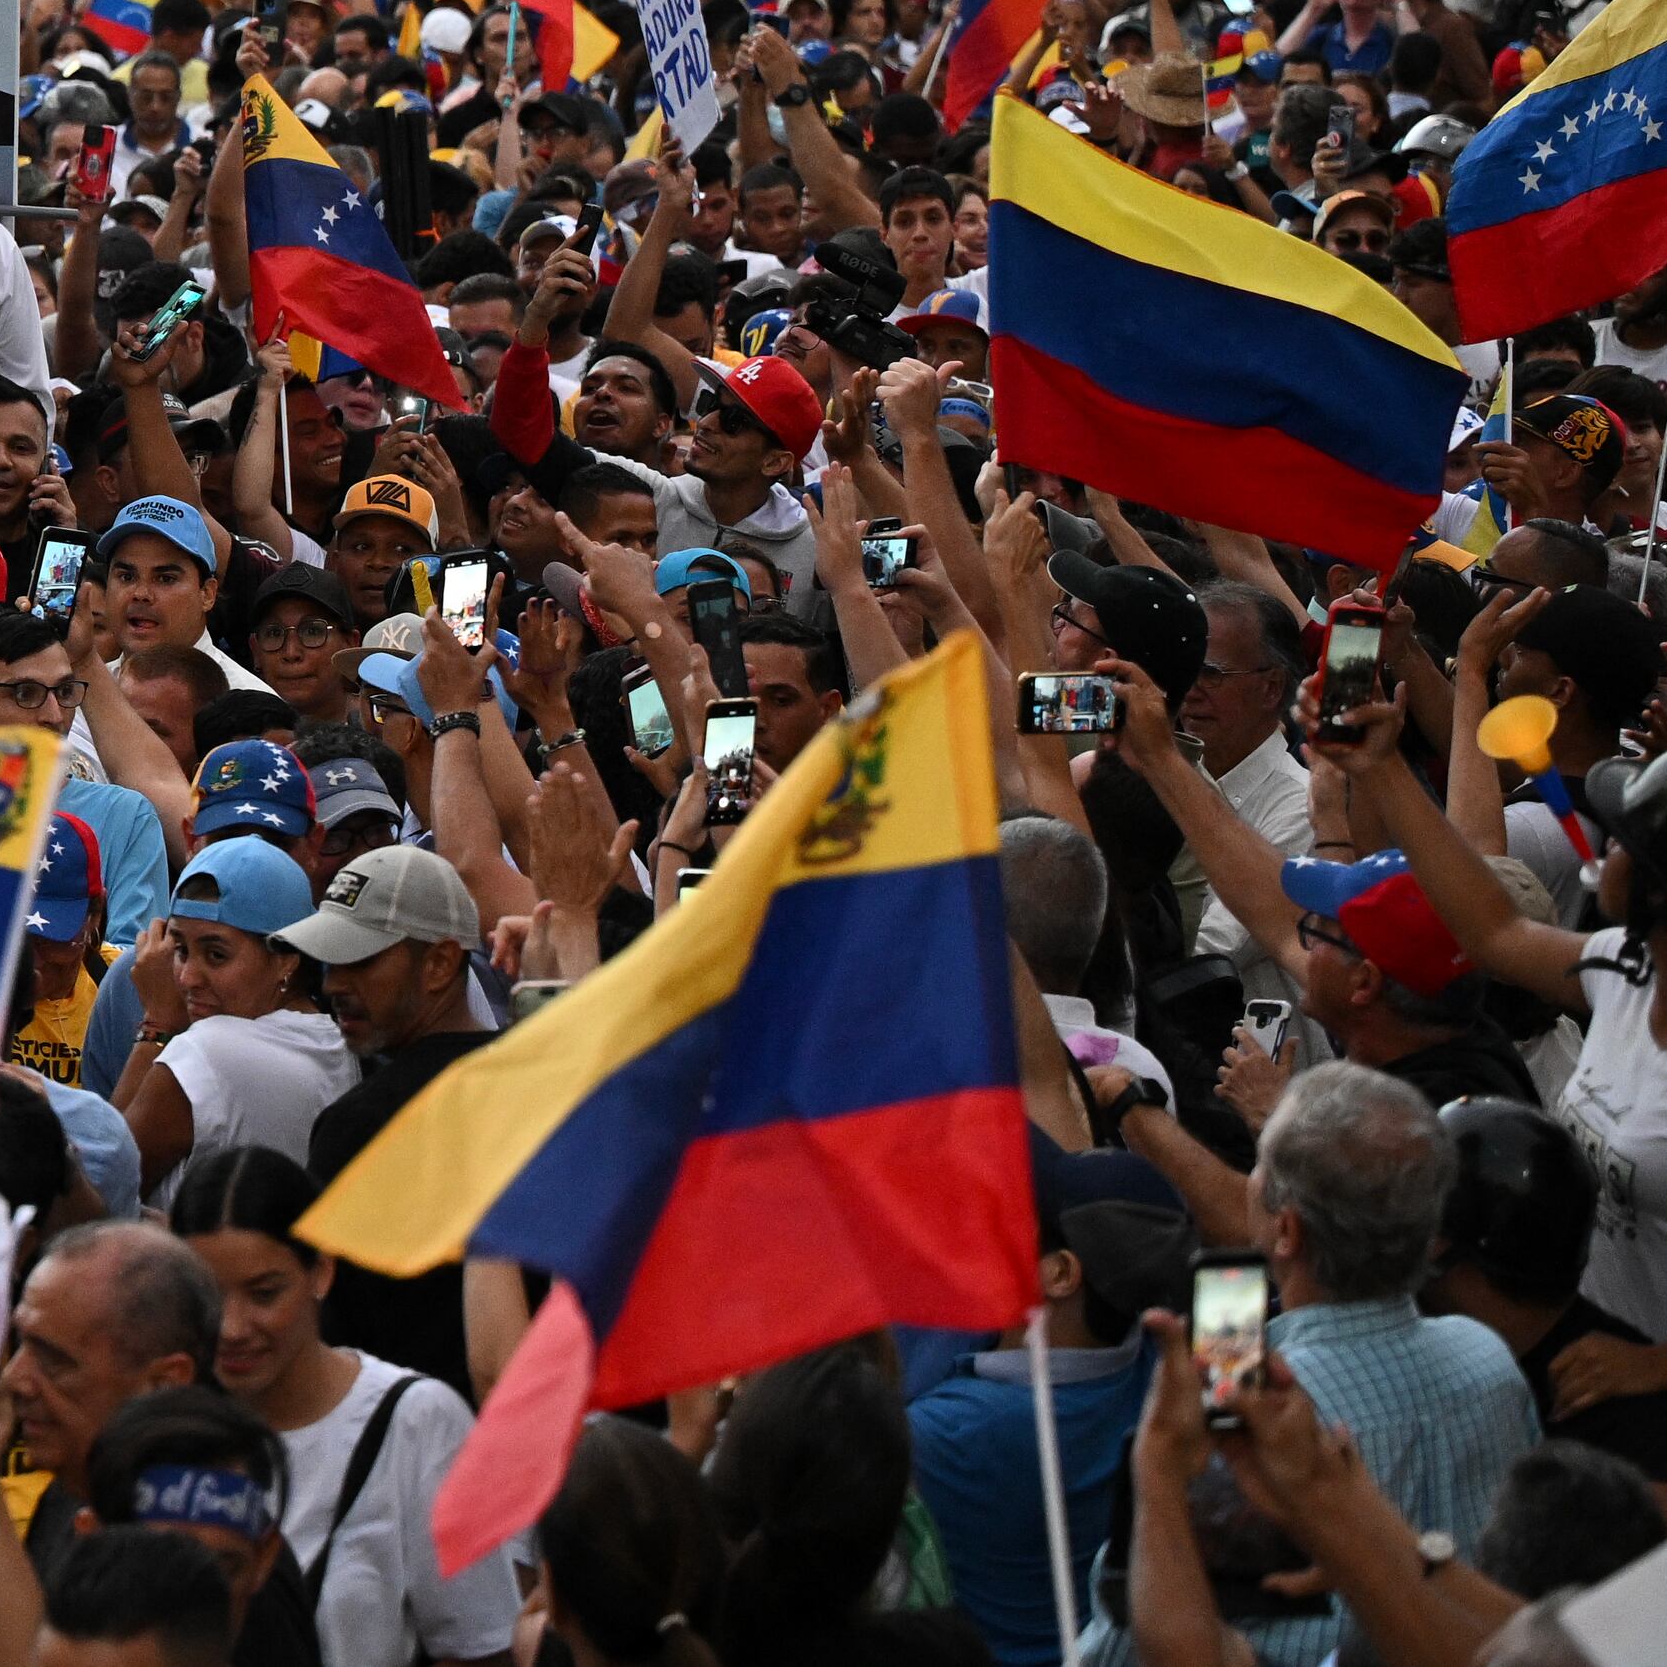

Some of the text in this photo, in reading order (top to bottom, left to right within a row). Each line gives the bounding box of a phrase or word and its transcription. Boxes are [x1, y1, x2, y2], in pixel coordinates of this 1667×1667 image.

[736, 359, 764, 385] LA
[126, 501, 184, 519] EDMUNDO
[129, 509, 176, 521] PRESIDENTE
[380, 622, 411, 650] NY
